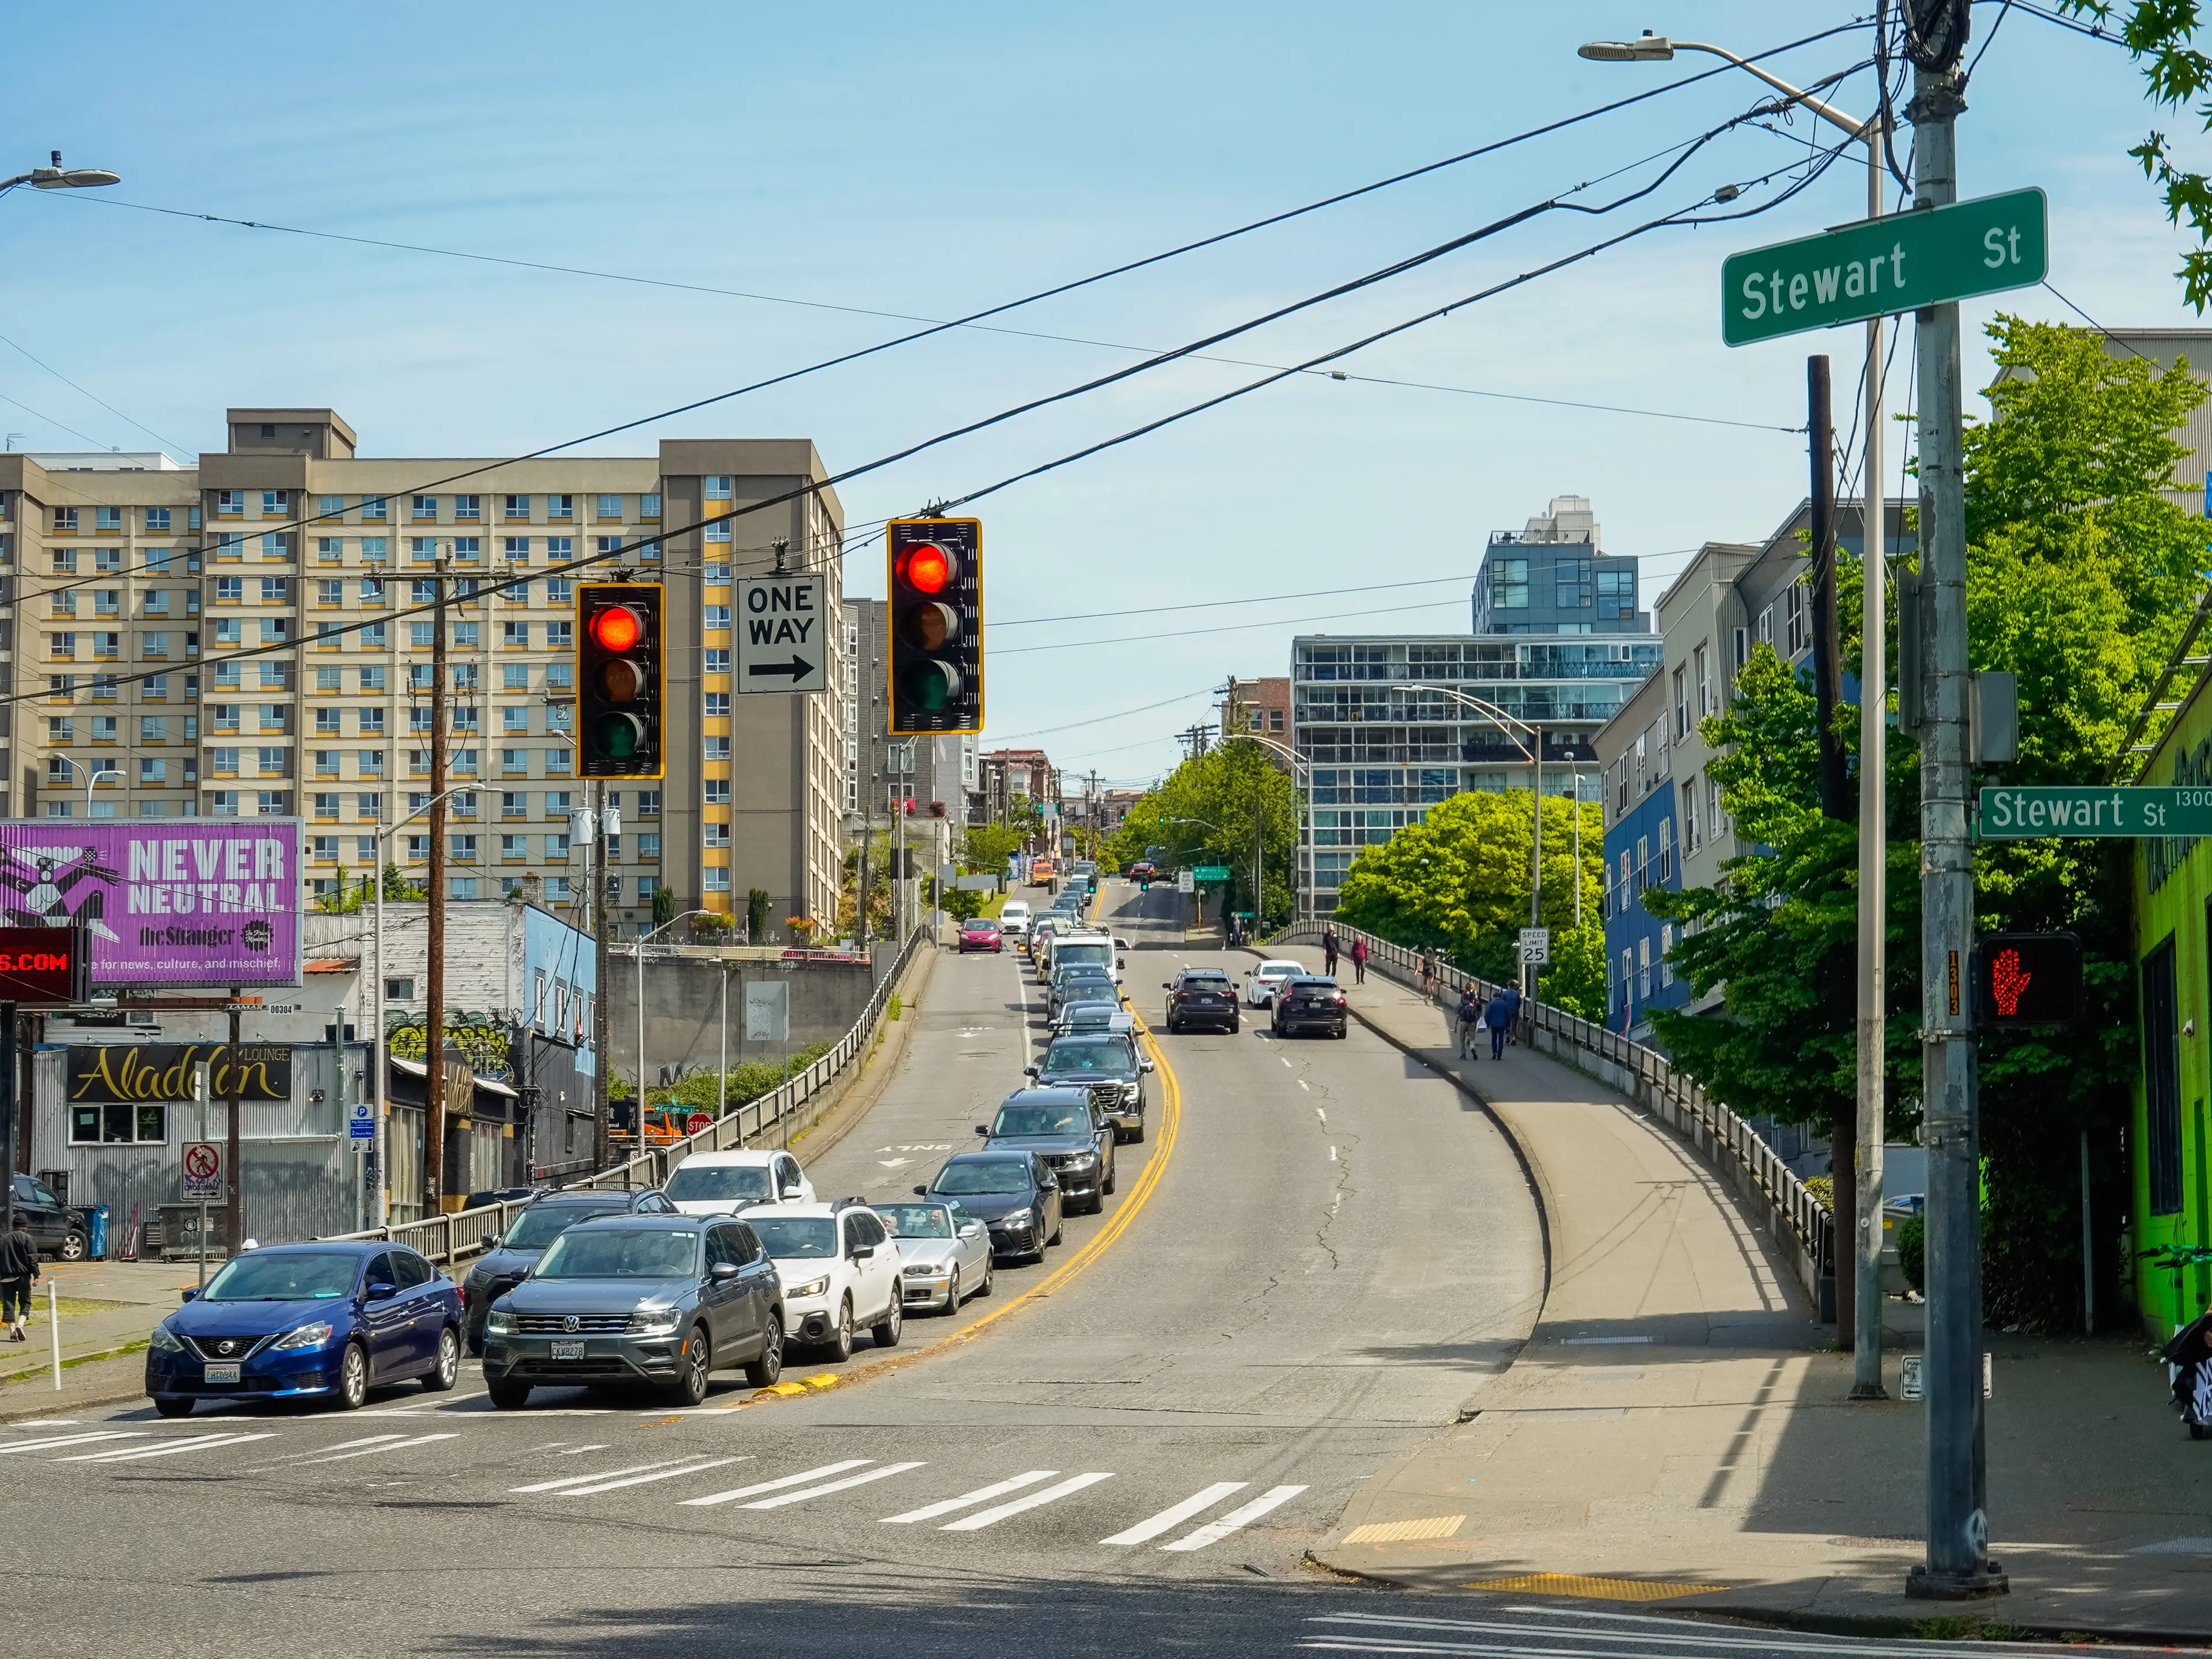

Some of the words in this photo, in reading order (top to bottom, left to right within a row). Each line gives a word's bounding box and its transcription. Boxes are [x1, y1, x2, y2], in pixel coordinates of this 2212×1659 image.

[1742, 242, 1906, 319] Stewart
[1983, 225, 2021, 268] St
[748, 585, 813, 613] ONE
[749, 618, 815, 645] WAY
[1993, 792, 2123, 827] Stewart
[2143, 803, 2166, 827] St
[2176, 791, 2212, 806] 1300
[128, 839, 284, 881] NEVER
[128, 883, 284, 914] NEUTRAL
[100, 959, 118, 969] for
[120, 961, 153, 970] news,
[157, 959, 201, 971] culture,
[204, 958, 226, 968] and
[1524, 948, 1544, 961] 25
[1949, 952, 1959, 1015] 1303
[271, 1005, 292, 1014] 00304
[245, 1048, 290, 1061] LOUNGE
[873, 1144, 953, 1152] ONLY
[552, 1347, 583, 1357] CKV8278
